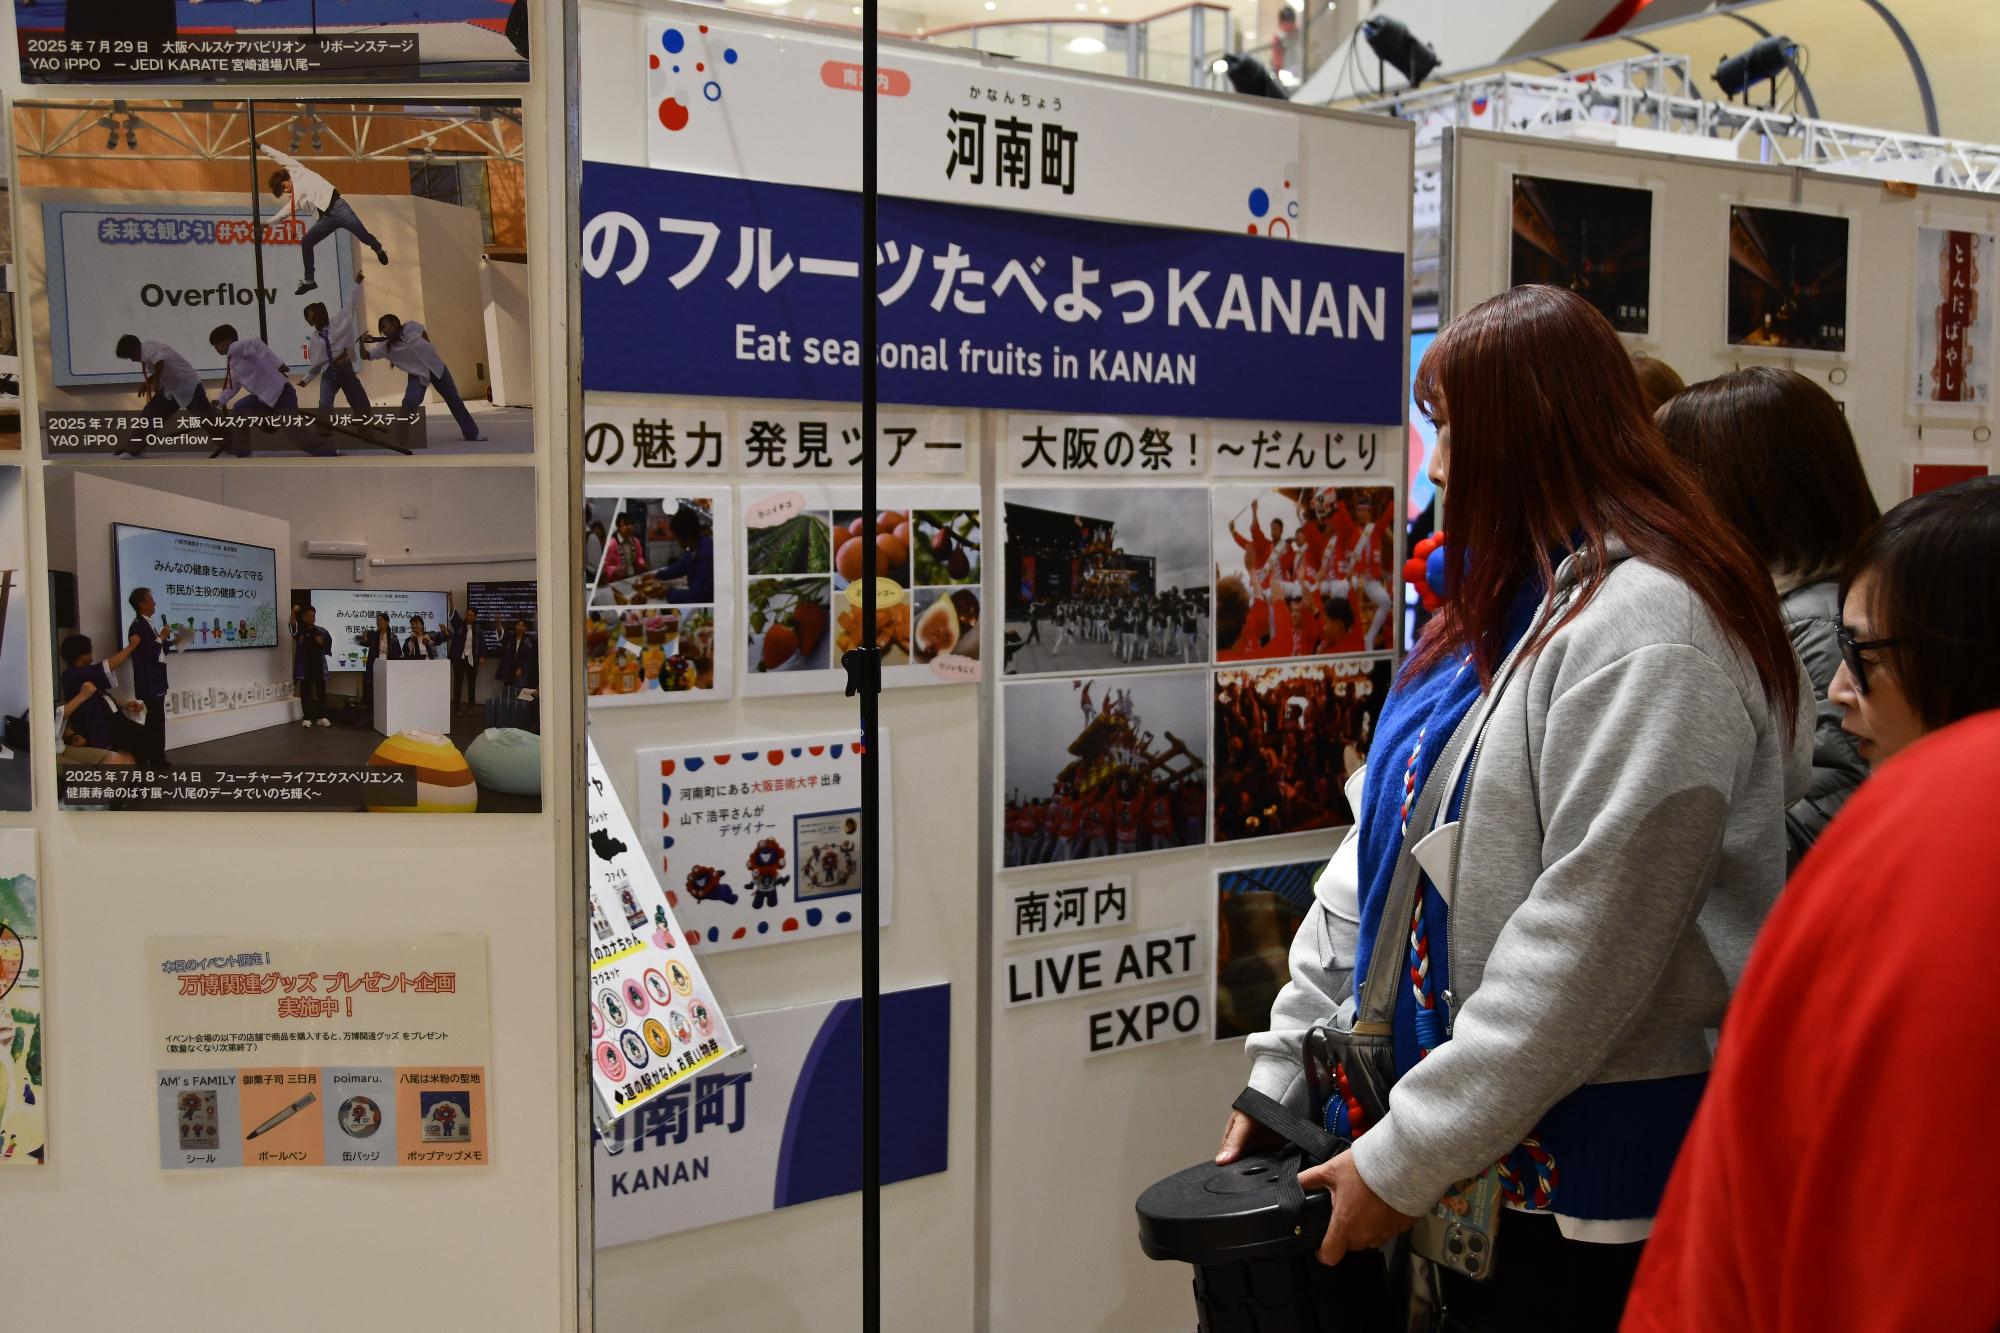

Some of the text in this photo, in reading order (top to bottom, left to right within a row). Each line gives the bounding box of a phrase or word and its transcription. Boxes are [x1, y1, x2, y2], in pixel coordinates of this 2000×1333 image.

[320, 40, 414, 54] リボーンステージ
[30, 58, 60, 71] YAO
[65, 57, 101, 71] iPPO
[130, 58, 163, 71] JEDI
[168, 58, 228, 71] KARATE
[969, 85, 1062, 112] かなんちょう
[945, 107, 1079, 195] 河南町
[141, 282, 278, 307] Overflow
[1944, 243, 1966, 391] とんだばやし
[735, 323, 1197, 386] Eat seaonal fruits in KANAN
[330, 412, 420, 427] リボーンステージ
[50, 434, 79, 447] YAO
[84, 434, 118, 447] iPPO
[146, 433, 209, 446] Overflow
[584, 417, 722, 470] の魅力
[1021, 425, 1197, 471] 大阪の祭！
[154, 560, 264, 581] みんなの健康をみんなで守る
[165, 584, 257, 599] 市民が主役の健康づくり
[215, 771, 404, 784] フューチャーライフエクスペリエンス
[820, 773, 842, 787] 出身
[719, 822, 776, 837] デザイナー
[1014, 882, 1126, 936] 南河内
[590, 934, 641, 964] のカナちゃん
[1008, 934, 1197, 1003] LIVE ART
[178, 971, 456, 996] 万博関連グッズ プレゼント企画
[278, 996, 353, 1018] 実施中！
[1089, 994, 1200, 1052] EXPO
[193, 1075, 236, 1086] FAMILY
[243, 1074, 317, 1085] 御菓子司 三日月
[333, 1073, 383, 1083] poimaru.
[400, 1073, 481, 1084] 八尾は米粉の聖地
[186, 1153, 216, 1163] シール
[258, 1151, 307, 1161] ボールペン
[342, 1151, 381, 1162] 缶バッジ
[407, 1151, 482, 1161] ポップアップメモ
[611, 1155, 709, 1198] KANAN
